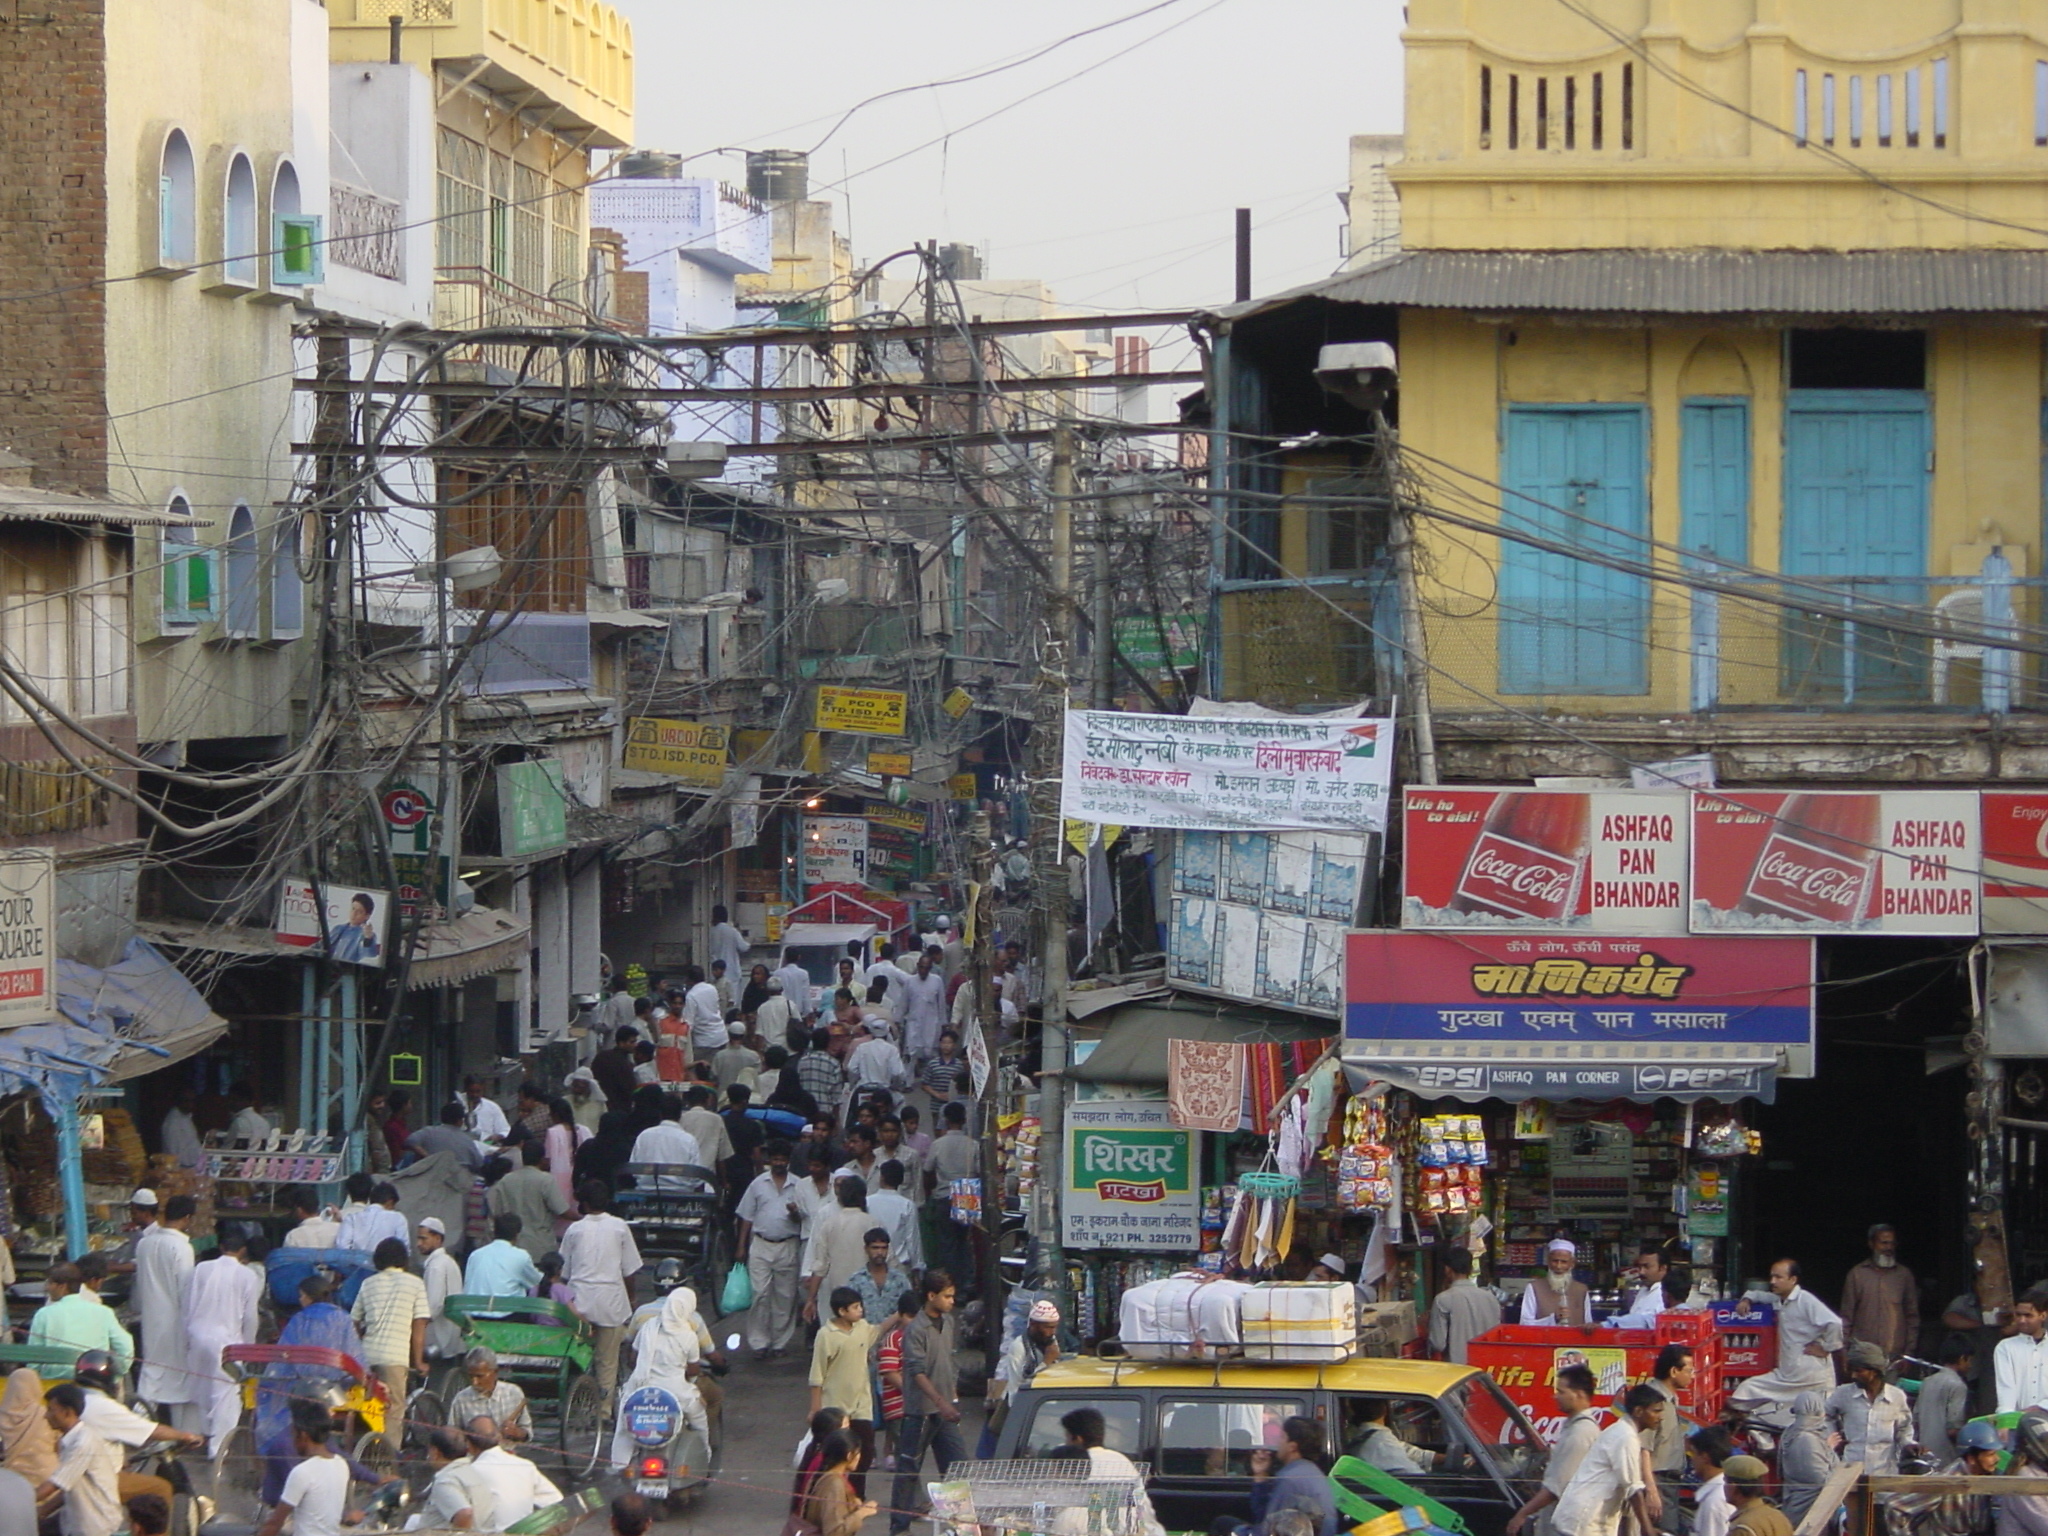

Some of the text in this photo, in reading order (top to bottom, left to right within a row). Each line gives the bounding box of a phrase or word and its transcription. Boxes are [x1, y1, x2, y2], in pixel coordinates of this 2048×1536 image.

[876, 710, 899, 718] FAX
[1407, 797, 1454, 811] Life ho
[2012, 805, 2048, 821] Enjoy
[1427, 811, 1479, 823] to aisi!
[1716, 813, 1732, 824] to
[1601, 814, 1674, 843] ASHFAQ
[1891, 820, 1965, 849] ASHFAQ
[1619, 848, 1655, 875] PAN
[1910, 854, 1947, 881] PAN
[1470, 849, 1572, 904] Coca-Cola
[1759, 851, 1862, 907] Coca-Cola
[1594, 881, 1680, 908] BHANDAR
[1883, 888, 1973, 915] BHANDAR
[285, 898, 340, 923] magc
[0, 928, 43, 960] UARE
[1506, 940, 1642, 954] ऊँचे लोग, ऊँची पसंद
[12, 973, 34, 994] PAN
[1472, 953, 1687, 998] माणिकचंद
[1437, 1010, 1728, 1033] गुटखा एवम् पान मसाला
[1492, 1070, 1619, 1085] ASHFAQ PAN CORNER
[1668, 1067, 1753, 1088] PEPSI
[1071, 1108, 1162, 1123] समझदार लोग, उचित
[1083, 1135, 1176, 1173] शिखर
[1104, 1184, 1158, 1198] गुटखा
[1120, 1212, 1139, 1227] चौक
[1106, 1233, 1124, 1243] 921
[1127, 1233, 1144, 1243] PH.
